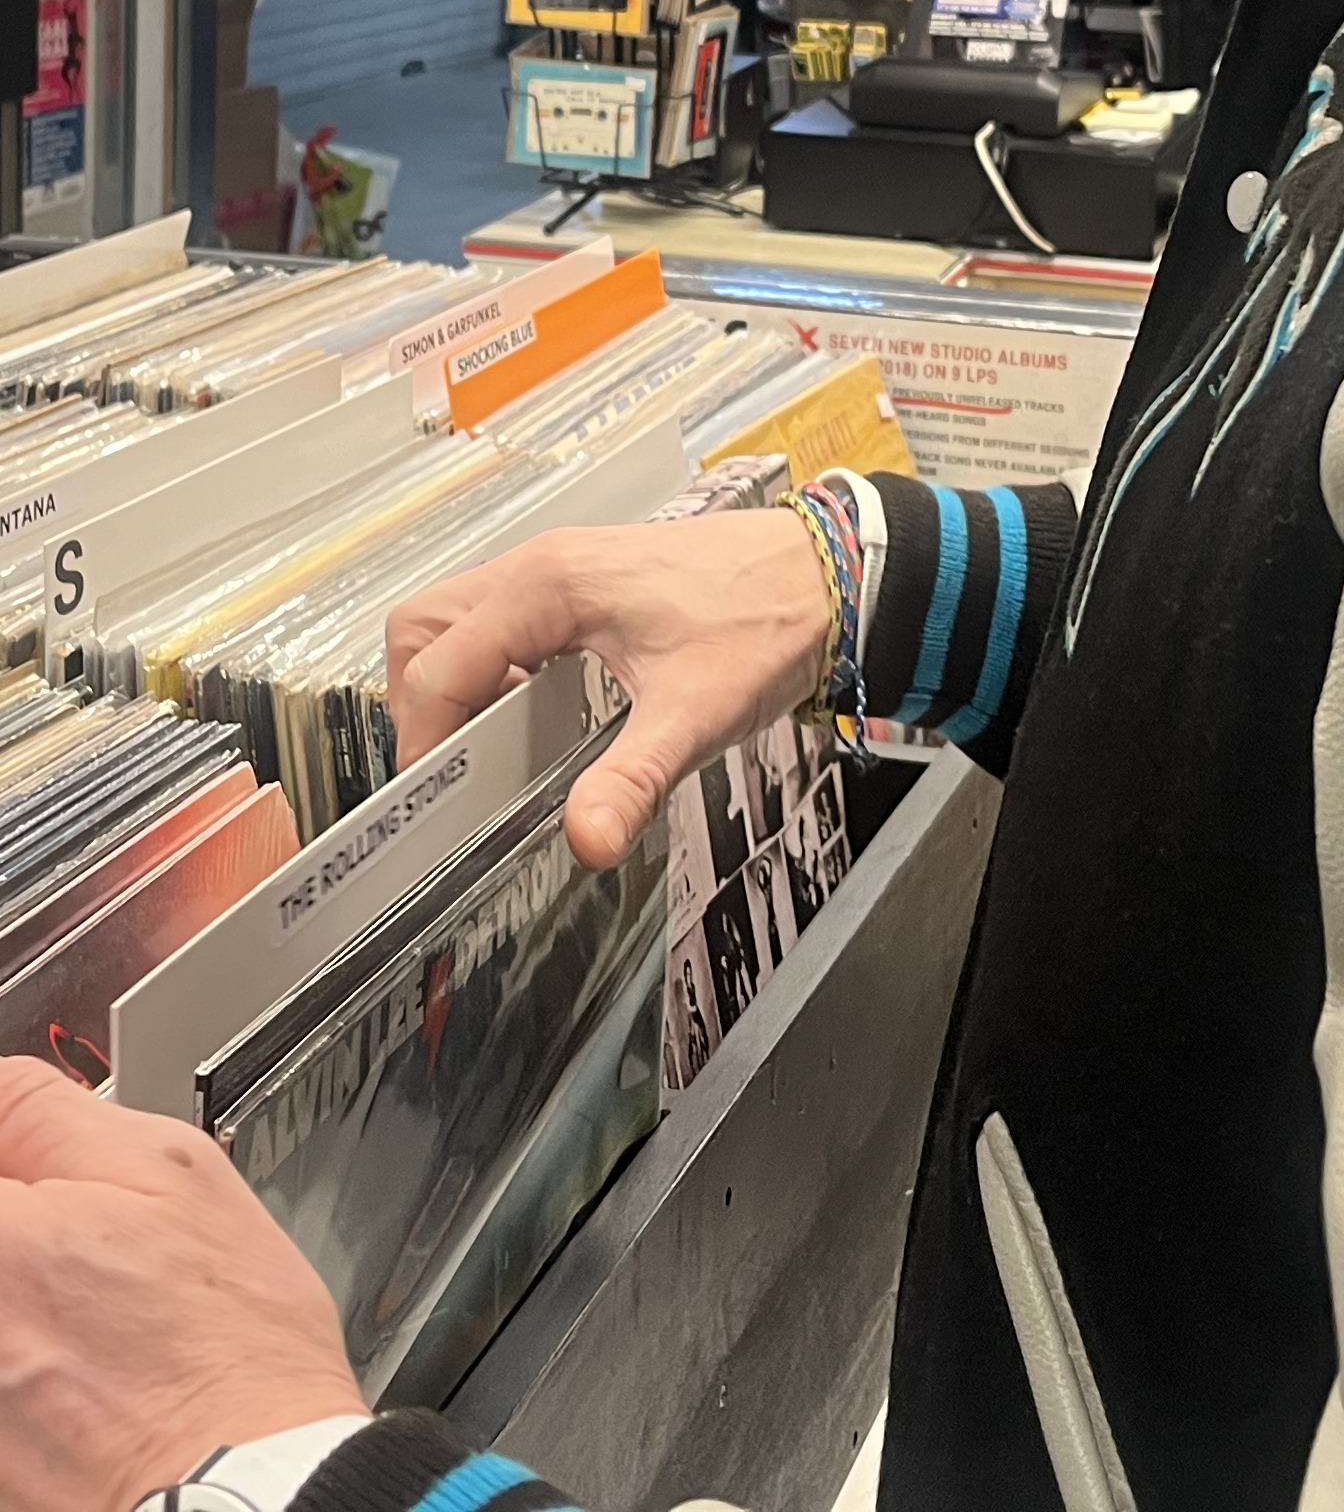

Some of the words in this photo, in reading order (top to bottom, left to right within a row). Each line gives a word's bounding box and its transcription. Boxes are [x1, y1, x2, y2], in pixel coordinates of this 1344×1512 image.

[401, 333, 436, 364] SIMON
[437, 328, 446, 346] &
[446, 301, 502, 341] GARFUNKEL
[457, 334, 509, 377] SHOCKING
[510, 320, 534, 348] BLUE
[828, 334, 883, 353] SEVEN
[887, 339, 924, 357] NEW
[930, 343, 992, 364] STUDIO
[997, 350, 1068, 371] ALBUMS
[922, 364, 946, 381] ON
[951, 366, 961, 382] 9
[965, 368, 998, 385] LPS
[955, 393, 1022, 410] UNRELEASED
[1024, 399, 1065, 414] TRACKS
[952, 433, 981, 446] FROM
[974, 458, 1008, 471] NEVER
[54, 539, 85, 616] S
[279, 875, 317, 930] THE
[320, 804, 401, 896] ROLLING
[404, 747, 469, 823] STONES
[247, 1025, 362, 1186] ALVIN
[368, 963, 426, 1064] LEE
